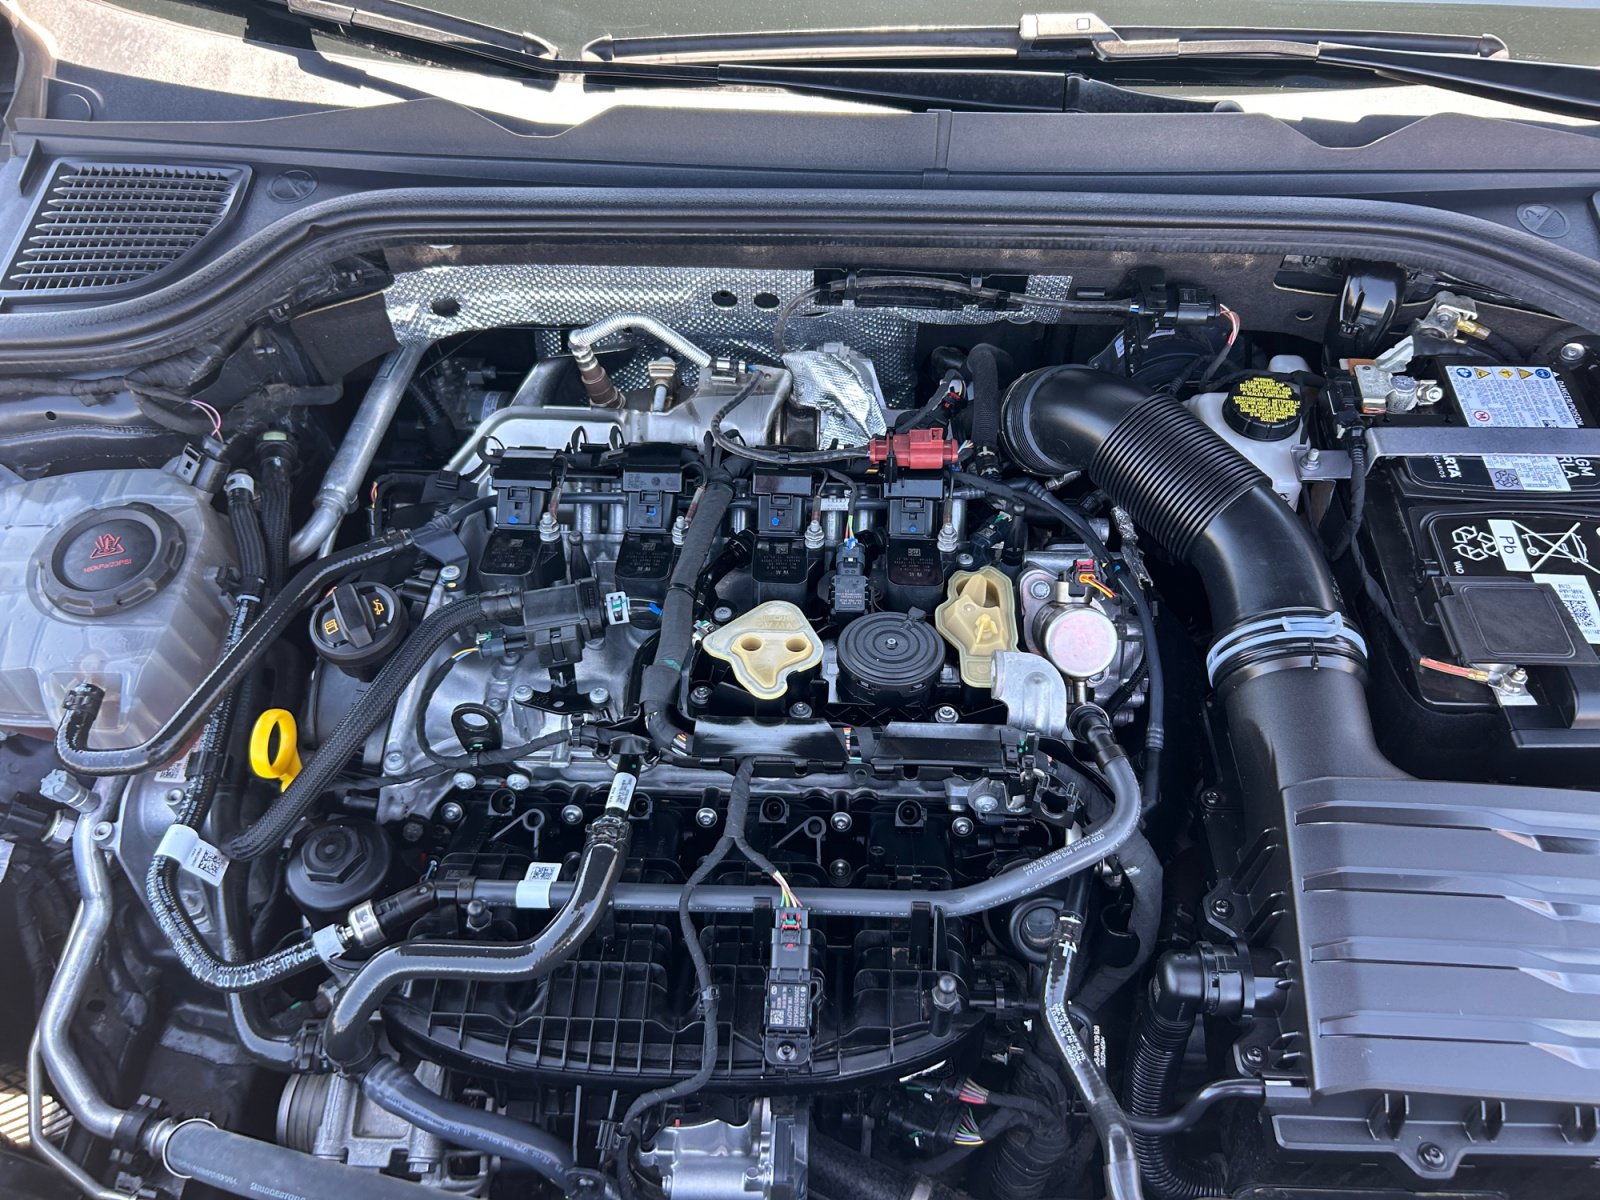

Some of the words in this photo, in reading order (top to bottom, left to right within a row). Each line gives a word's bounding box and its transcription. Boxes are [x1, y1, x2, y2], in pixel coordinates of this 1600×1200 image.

[1557, 381, 1584, 425] DANGER/POISON
[1432, 455, 1446, 478] CLARIOS
[1443, 455, 1461, 478] RTA
[1558, 457, 1579, 479] RLA
[1572, 457, 1596, 477] GM
[1499, 535, 1517, 554] Pb
[216, 974, 231, 987] 30
[242, 971, 258, 985] 23
